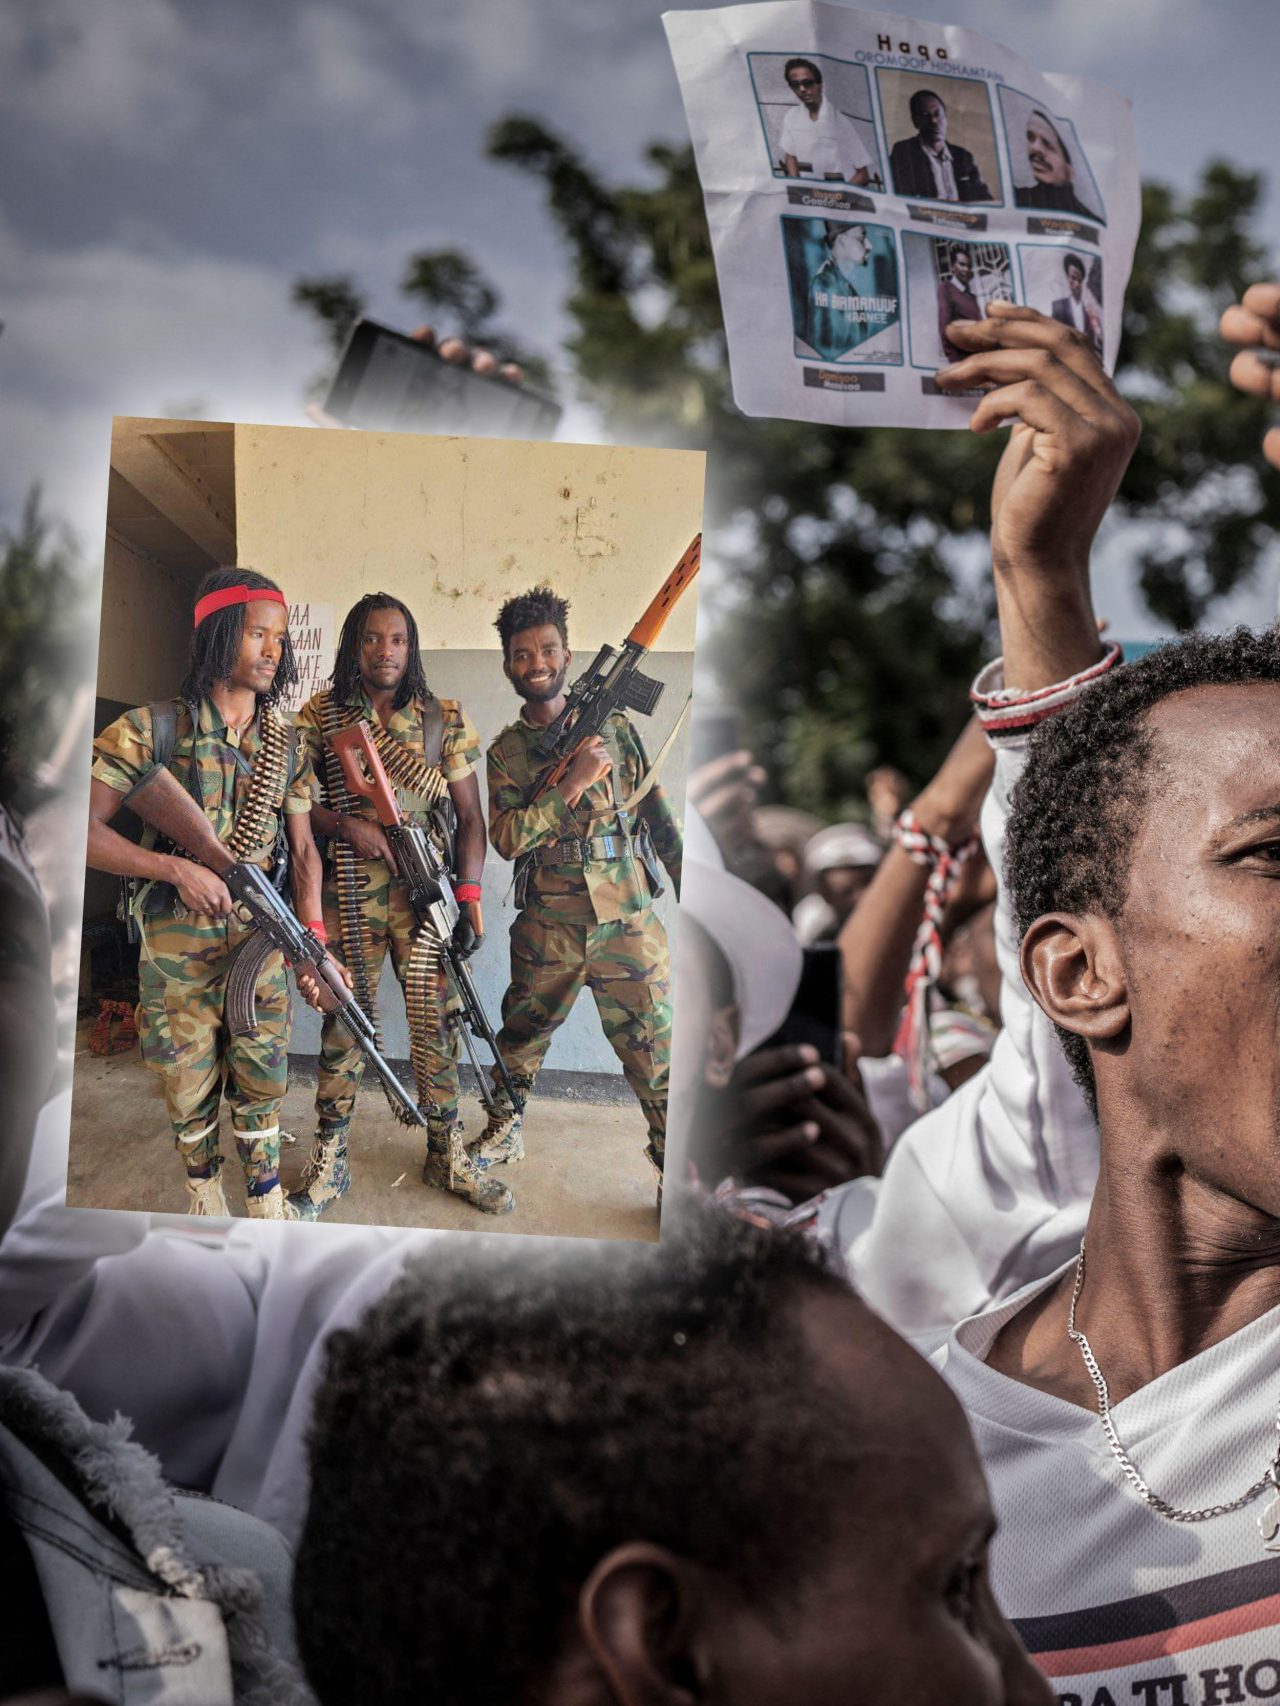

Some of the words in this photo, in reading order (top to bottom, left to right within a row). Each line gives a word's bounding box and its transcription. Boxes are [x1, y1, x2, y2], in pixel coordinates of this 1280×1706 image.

[854, 50, 929, 69] OROMOOF
[877, 34, 948, 60] Haqa
[1131, 1674, 1189, 1706] TI
